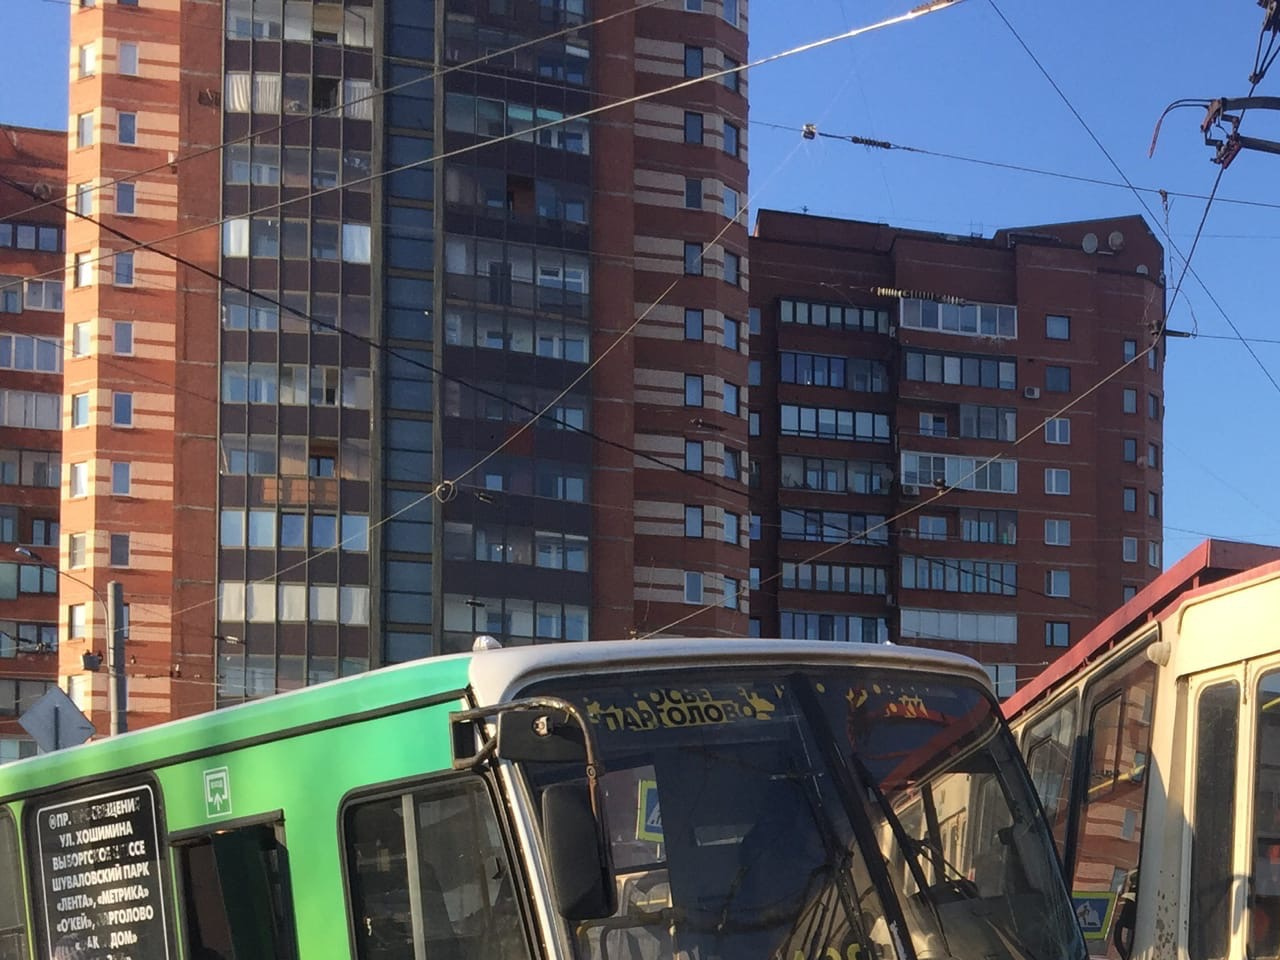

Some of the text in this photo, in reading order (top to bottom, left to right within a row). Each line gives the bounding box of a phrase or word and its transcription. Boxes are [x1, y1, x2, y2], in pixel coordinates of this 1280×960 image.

[60, 821, 133, 848] УЛ. ХОШИМИНА
[52, 862, 150, 892] ШУВАЛОВСКИЙ ПАРК
[57, 885, 149, 912] «ЛЕНТА», «МЕТРИКА»
